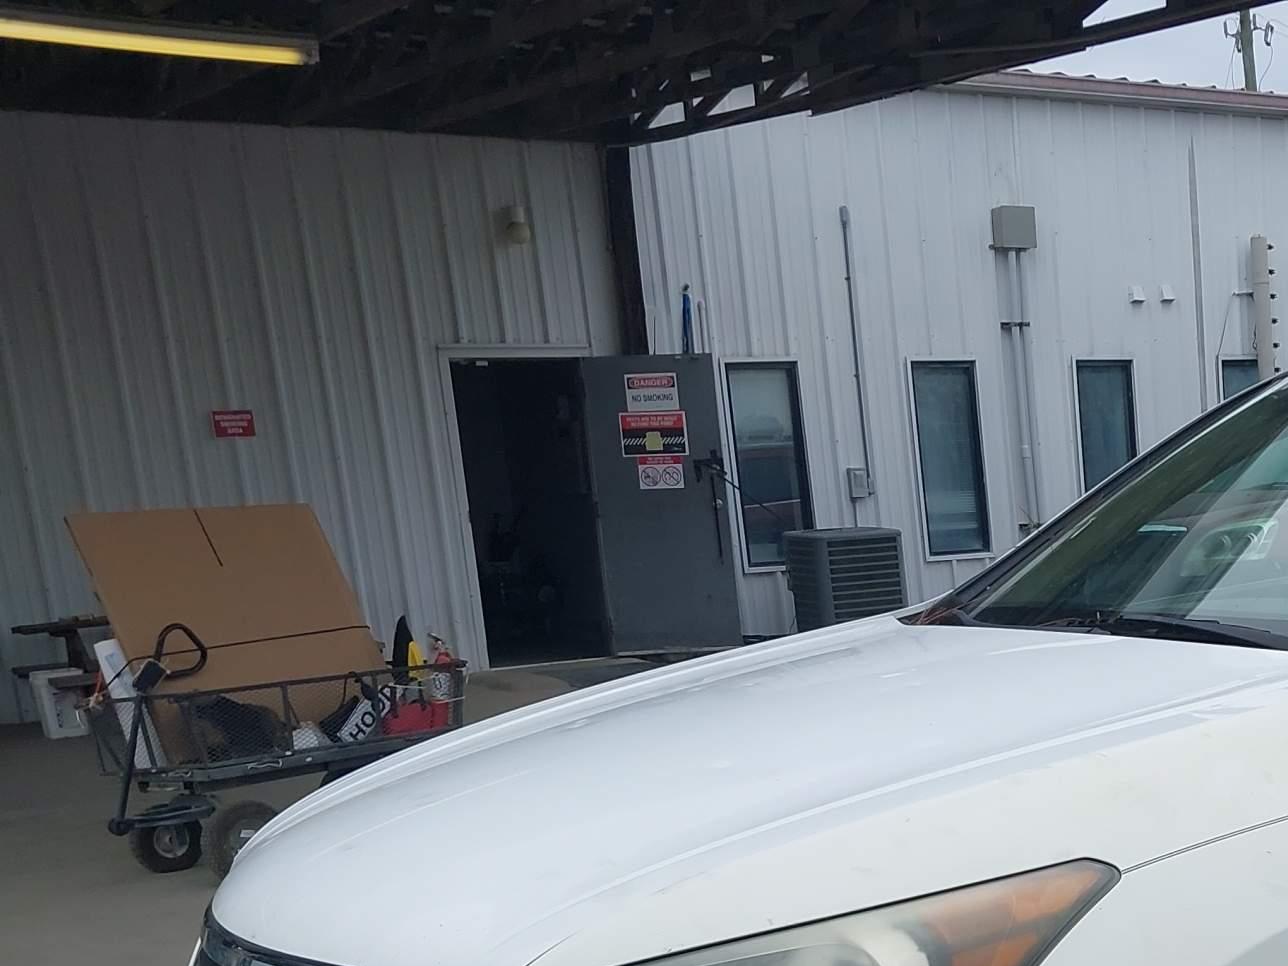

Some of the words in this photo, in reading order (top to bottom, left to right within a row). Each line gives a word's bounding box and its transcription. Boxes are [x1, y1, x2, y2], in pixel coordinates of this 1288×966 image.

[634, 378, 668, 386] DANGER
[632, 394, 641, 402] NO
[642, 393, 673, 402] SMOKING
